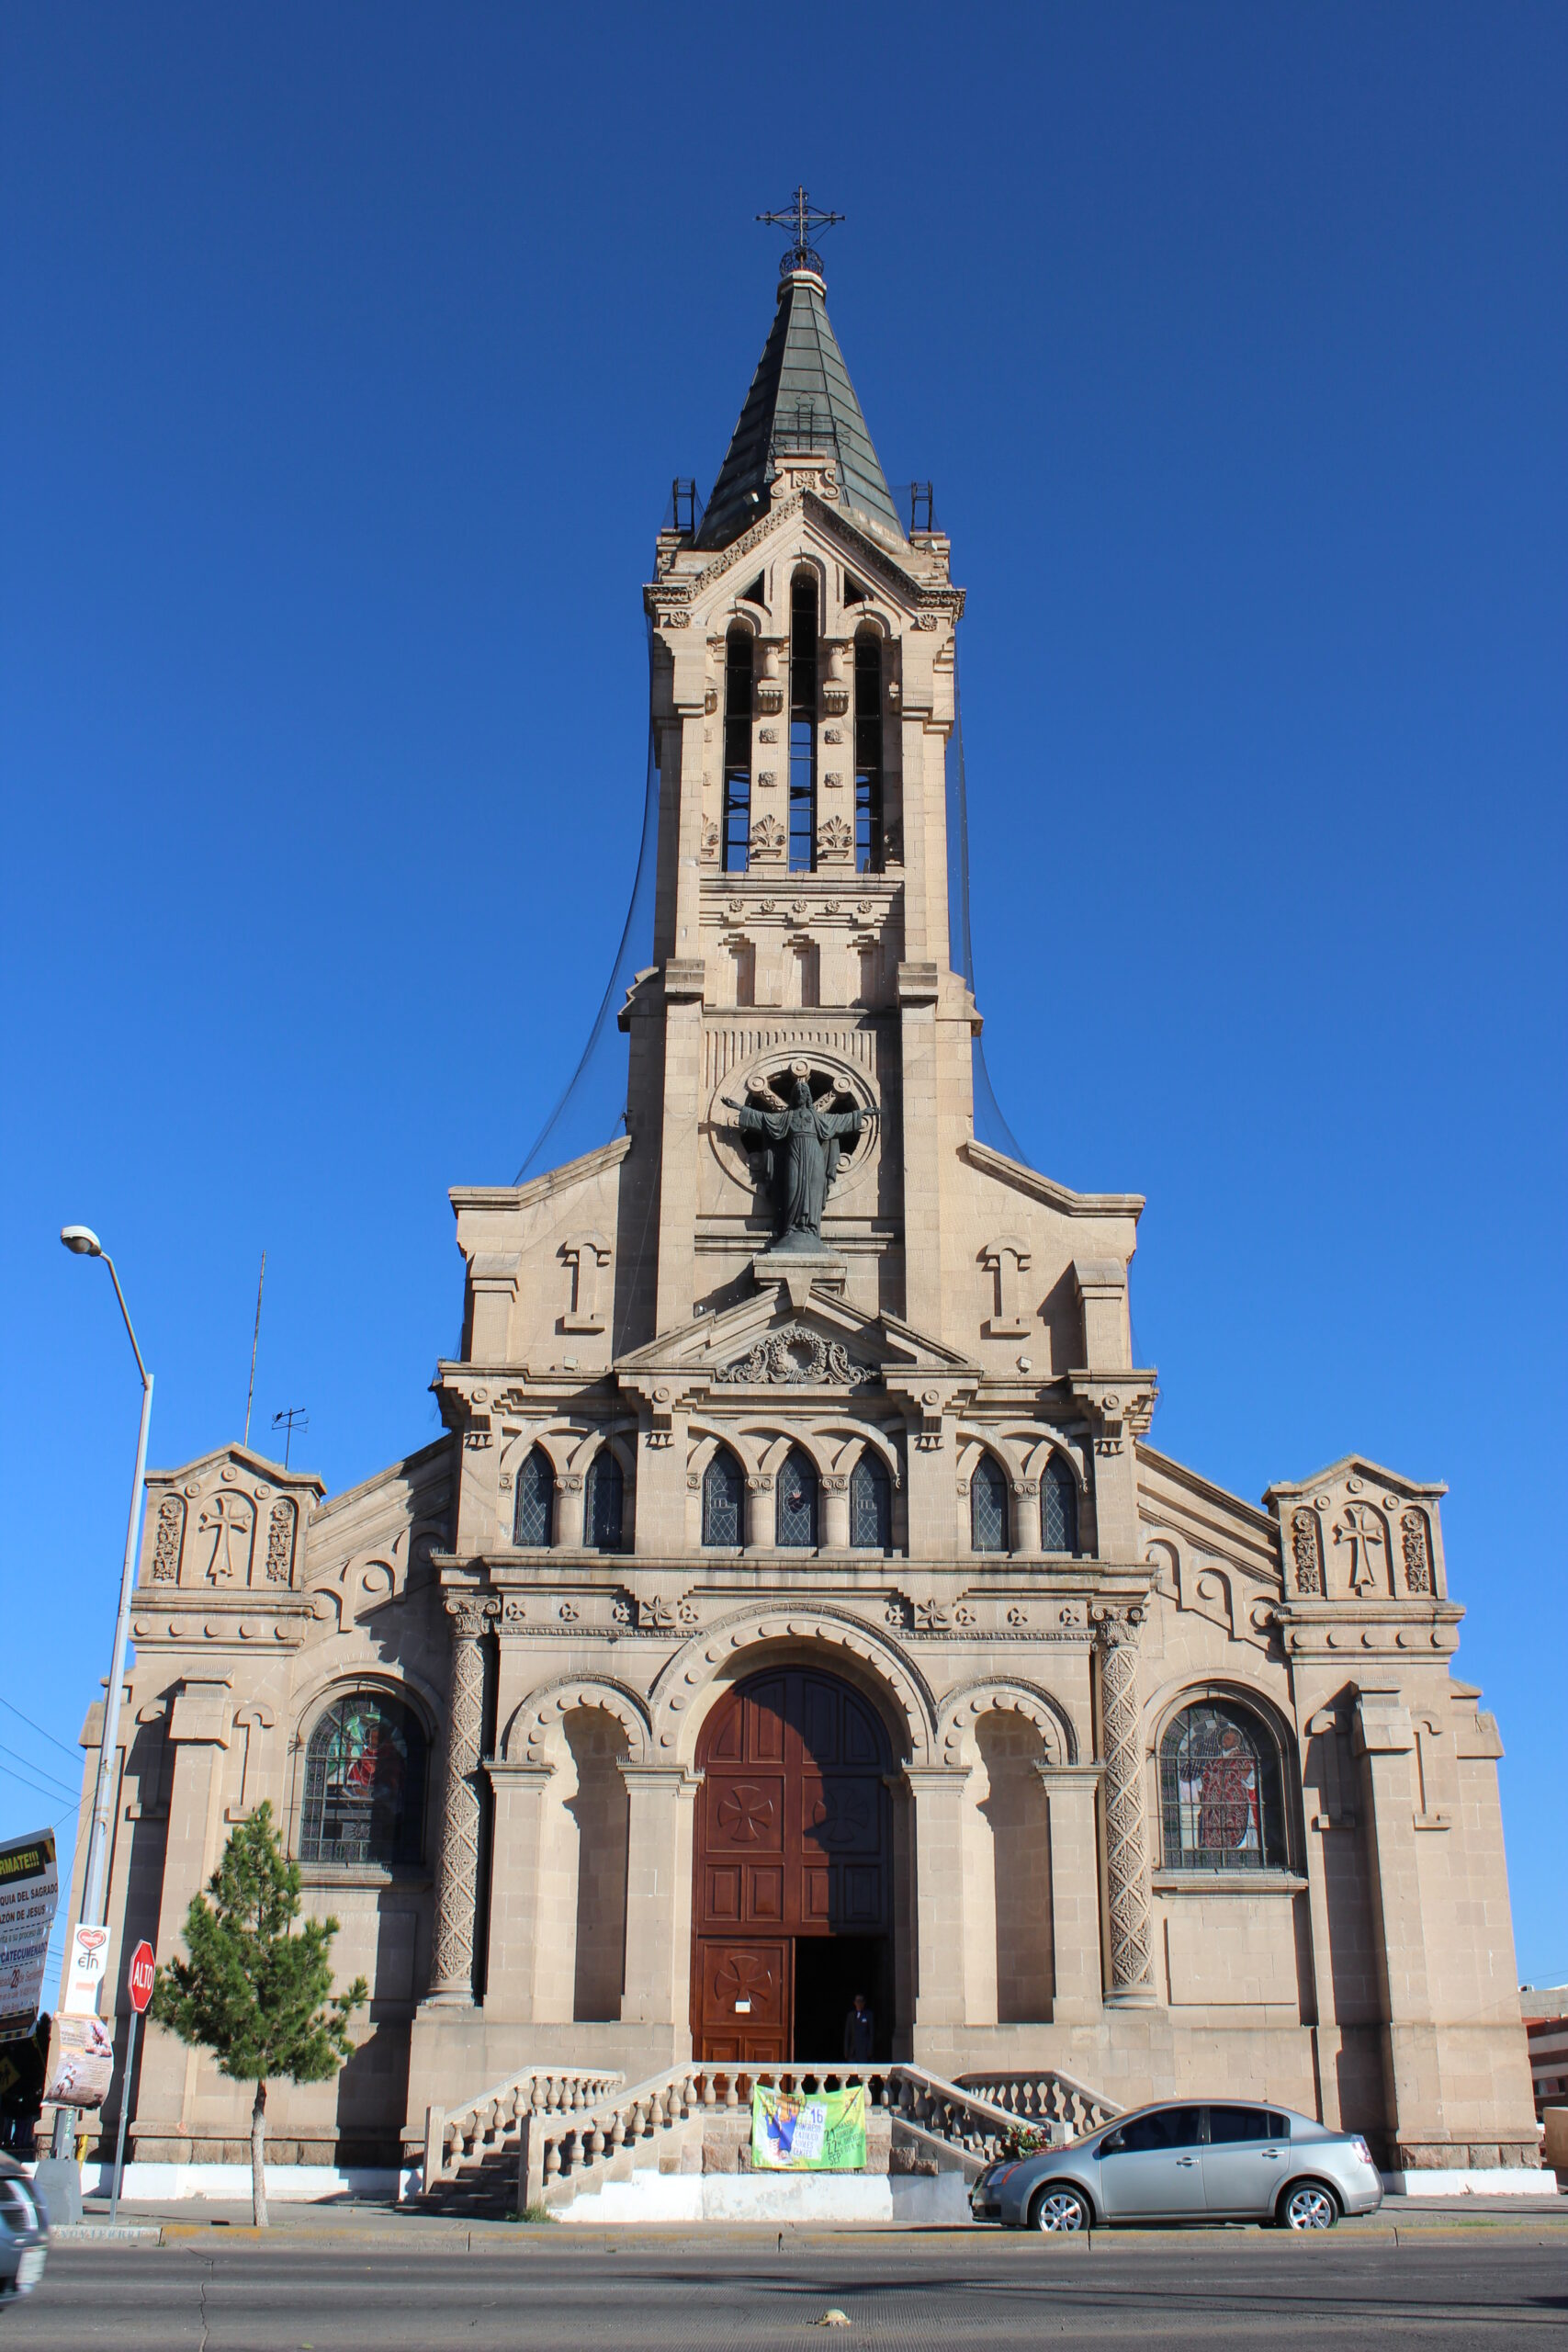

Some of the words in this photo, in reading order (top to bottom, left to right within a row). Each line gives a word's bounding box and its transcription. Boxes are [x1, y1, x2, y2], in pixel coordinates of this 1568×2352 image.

[17, 1890, 29, 1903] DEL
[30, 1883, 58, 1899] SAGRADO
[17, 1909, 25, 1921] DE
[132, 1961, 153, 1990] ALTO
[810, 2108, 823, 2124] 16
[824, 2128, 836, 2142] 21
[826, 2140, 840, 2154] 22
[828, 2153, 841, 2165] SEP
